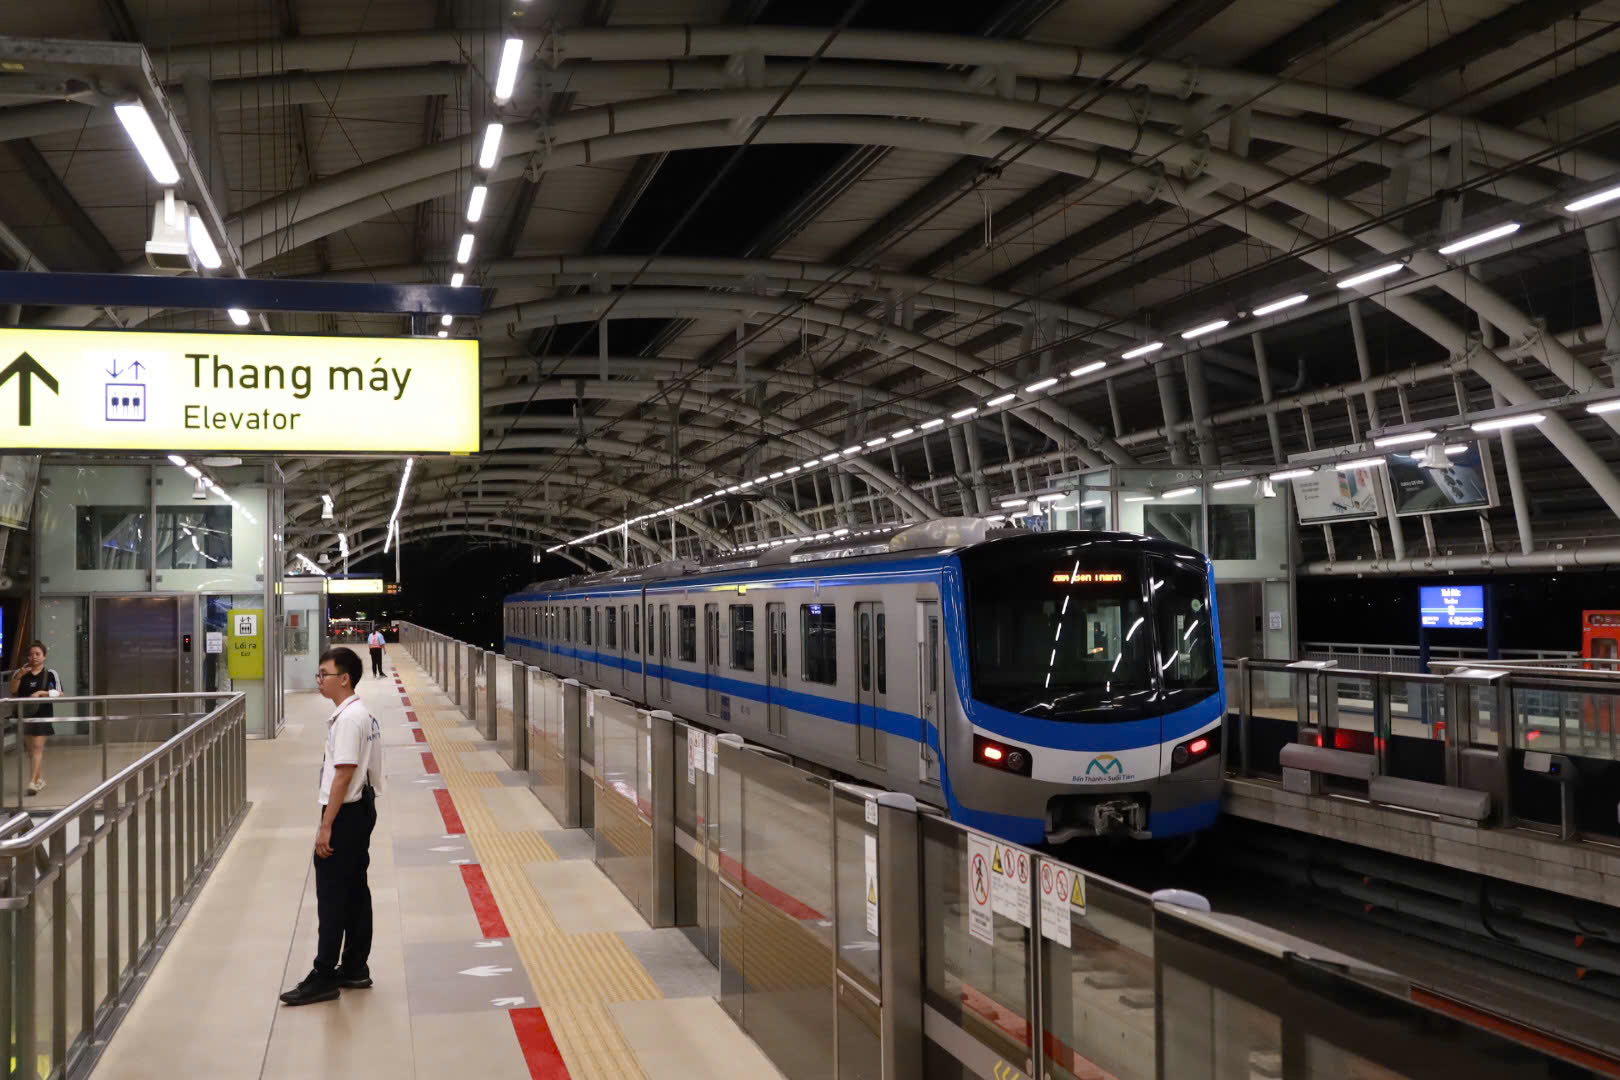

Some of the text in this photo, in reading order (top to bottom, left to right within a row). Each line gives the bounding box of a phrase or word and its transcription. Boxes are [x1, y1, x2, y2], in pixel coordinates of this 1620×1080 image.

[185, 353, 412, 400] Thang máy
[185, 405, 301, 429] Elevator
